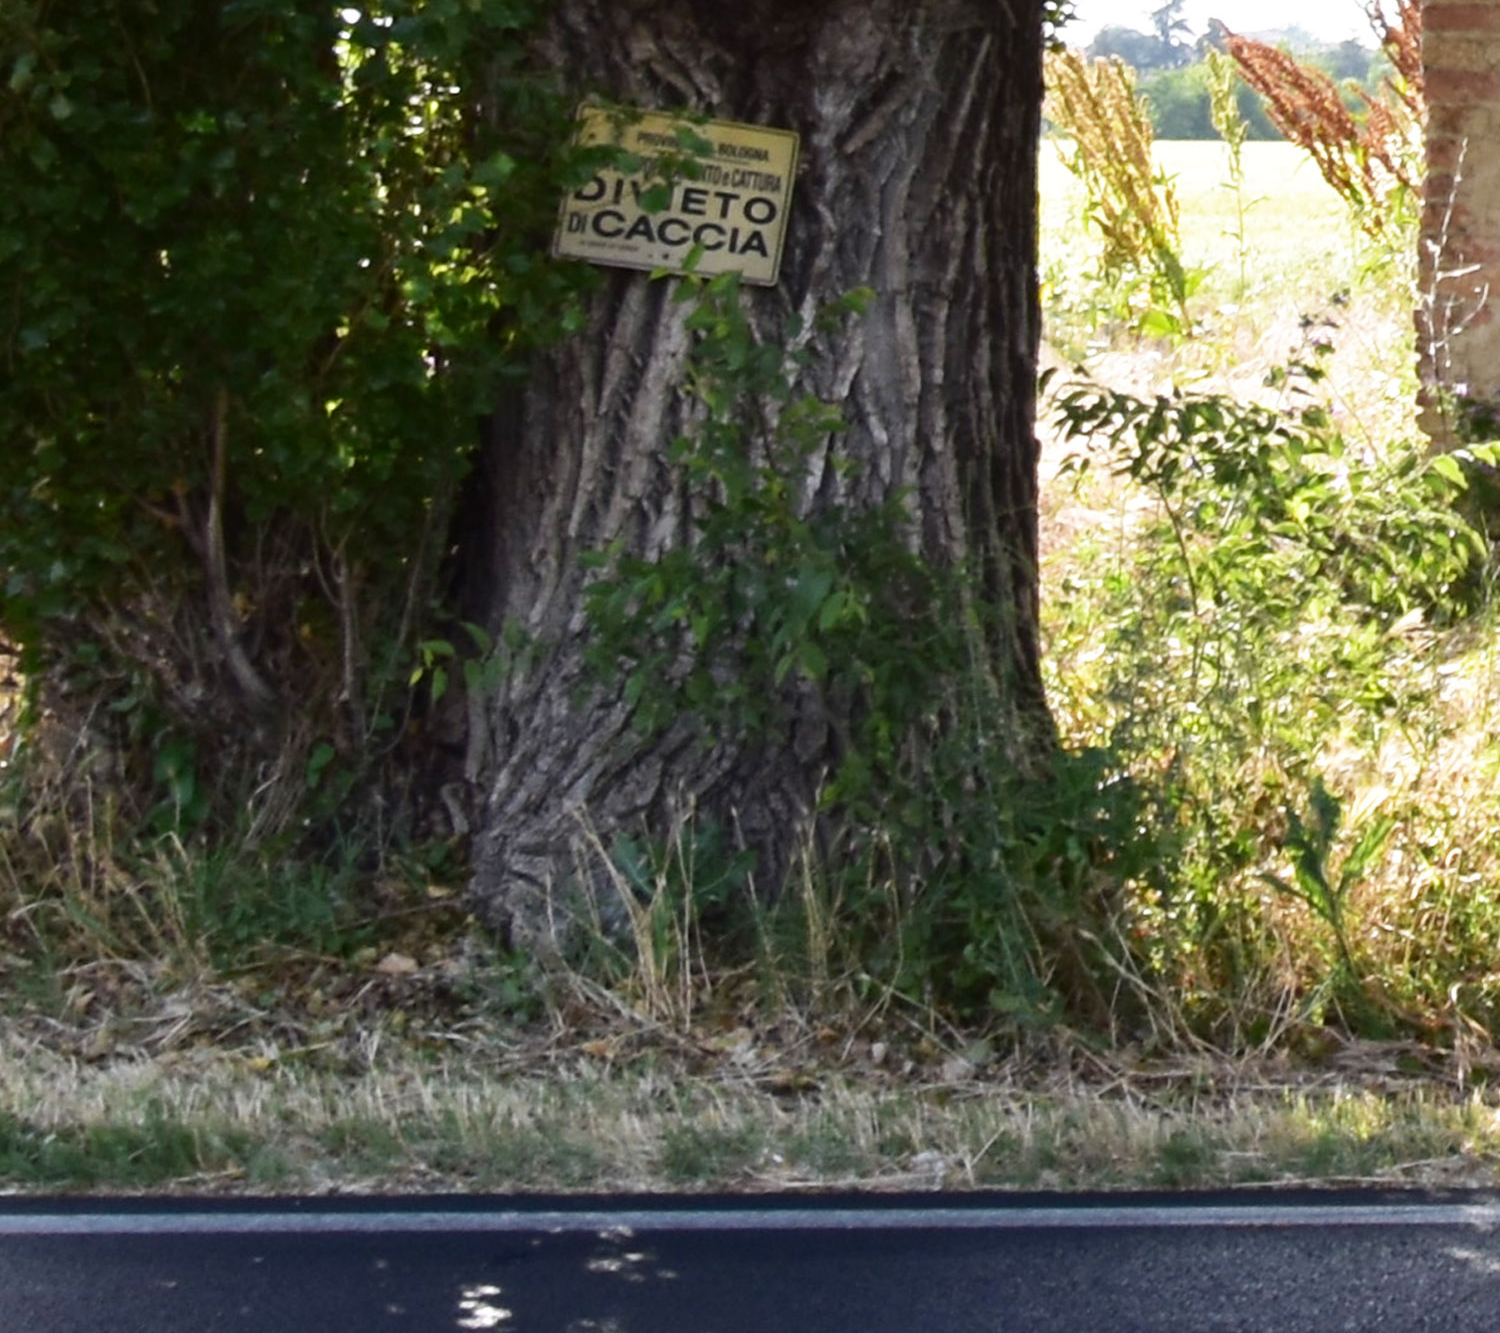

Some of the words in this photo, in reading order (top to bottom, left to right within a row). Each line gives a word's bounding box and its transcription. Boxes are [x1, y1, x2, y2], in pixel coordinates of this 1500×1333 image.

[718, 143, 768, 162] BOLOGNA
[731, 168, 781, 193] CATTURA
[574, 176, 777, 225] DIVETO
[567, 212, 588, 233] DI
[592, 210, 769, 258] CACCIA
